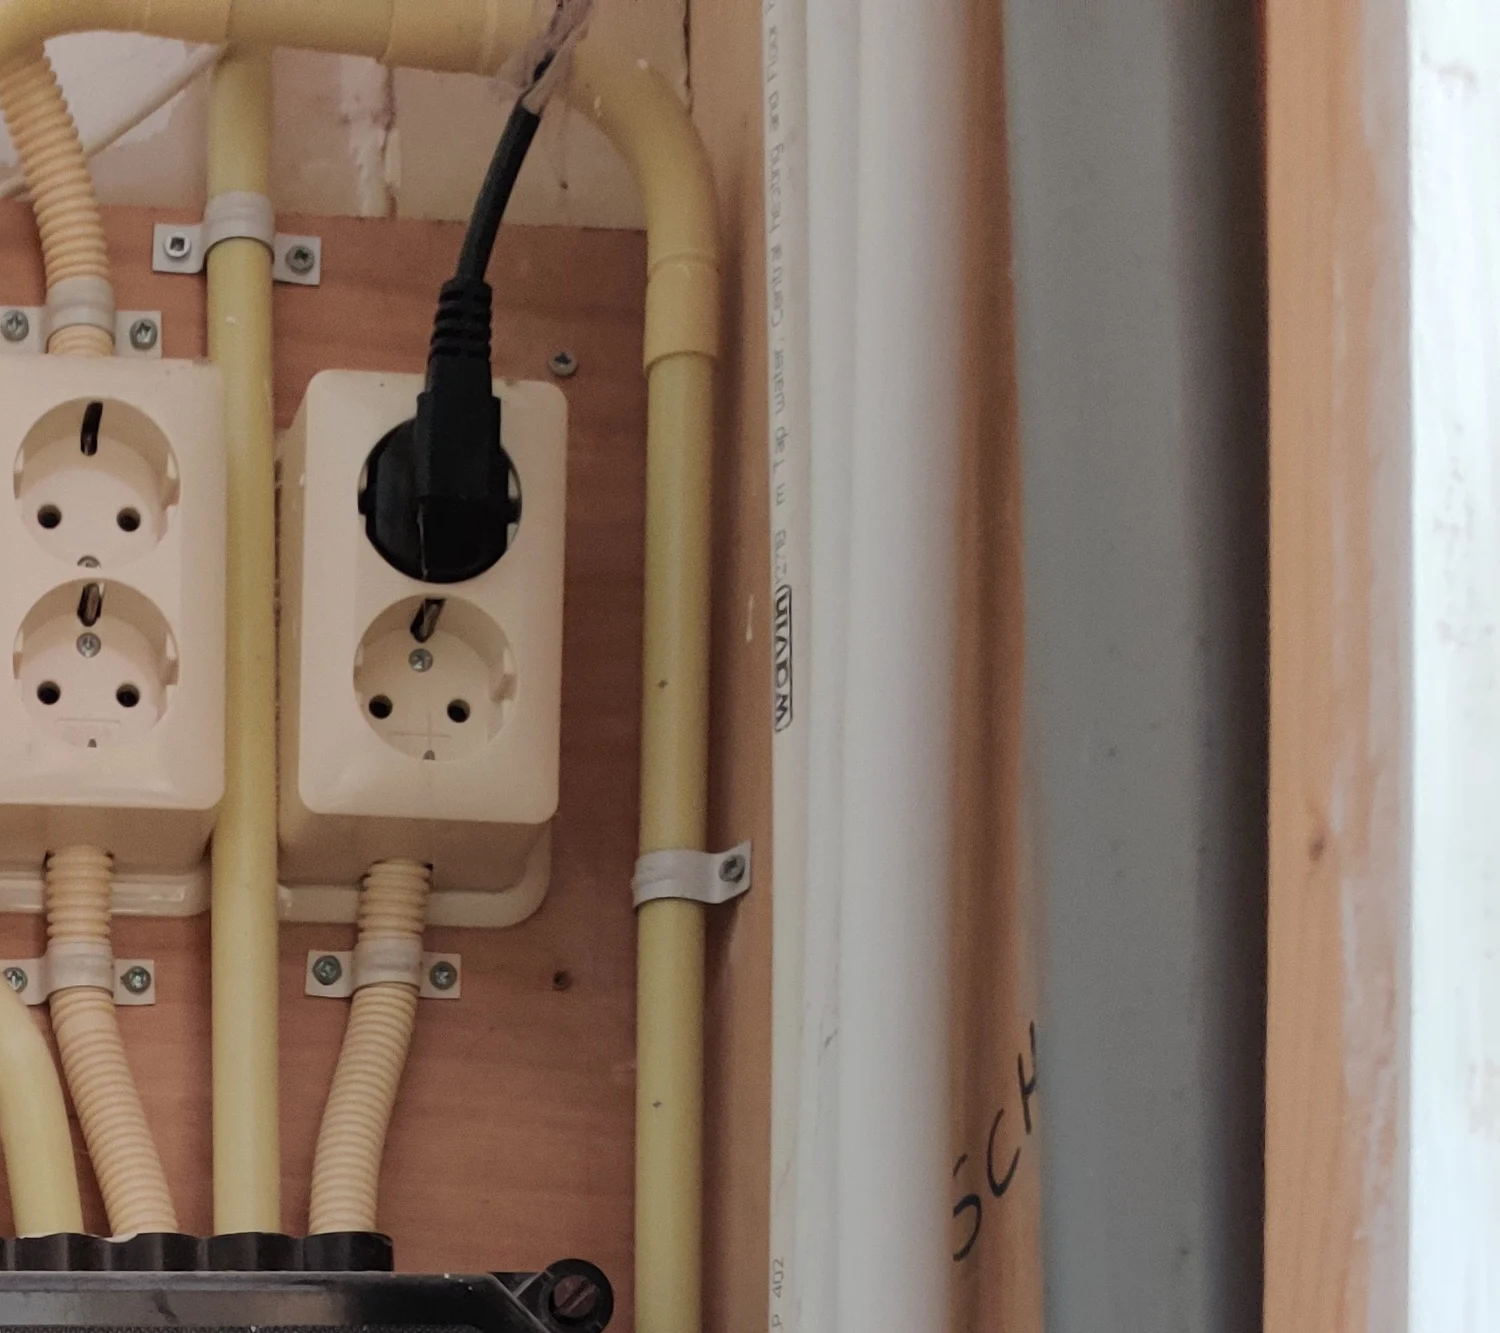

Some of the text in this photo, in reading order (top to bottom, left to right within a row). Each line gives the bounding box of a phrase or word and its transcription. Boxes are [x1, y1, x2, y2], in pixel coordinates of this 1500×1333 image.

[768, 91, 780, 131] and
[768, 142, 785, 233] heating
[769, 244, 783, 328] Central
[772, 425, 788, 469] Tap
[771, 1255, 785, 1299] 402
